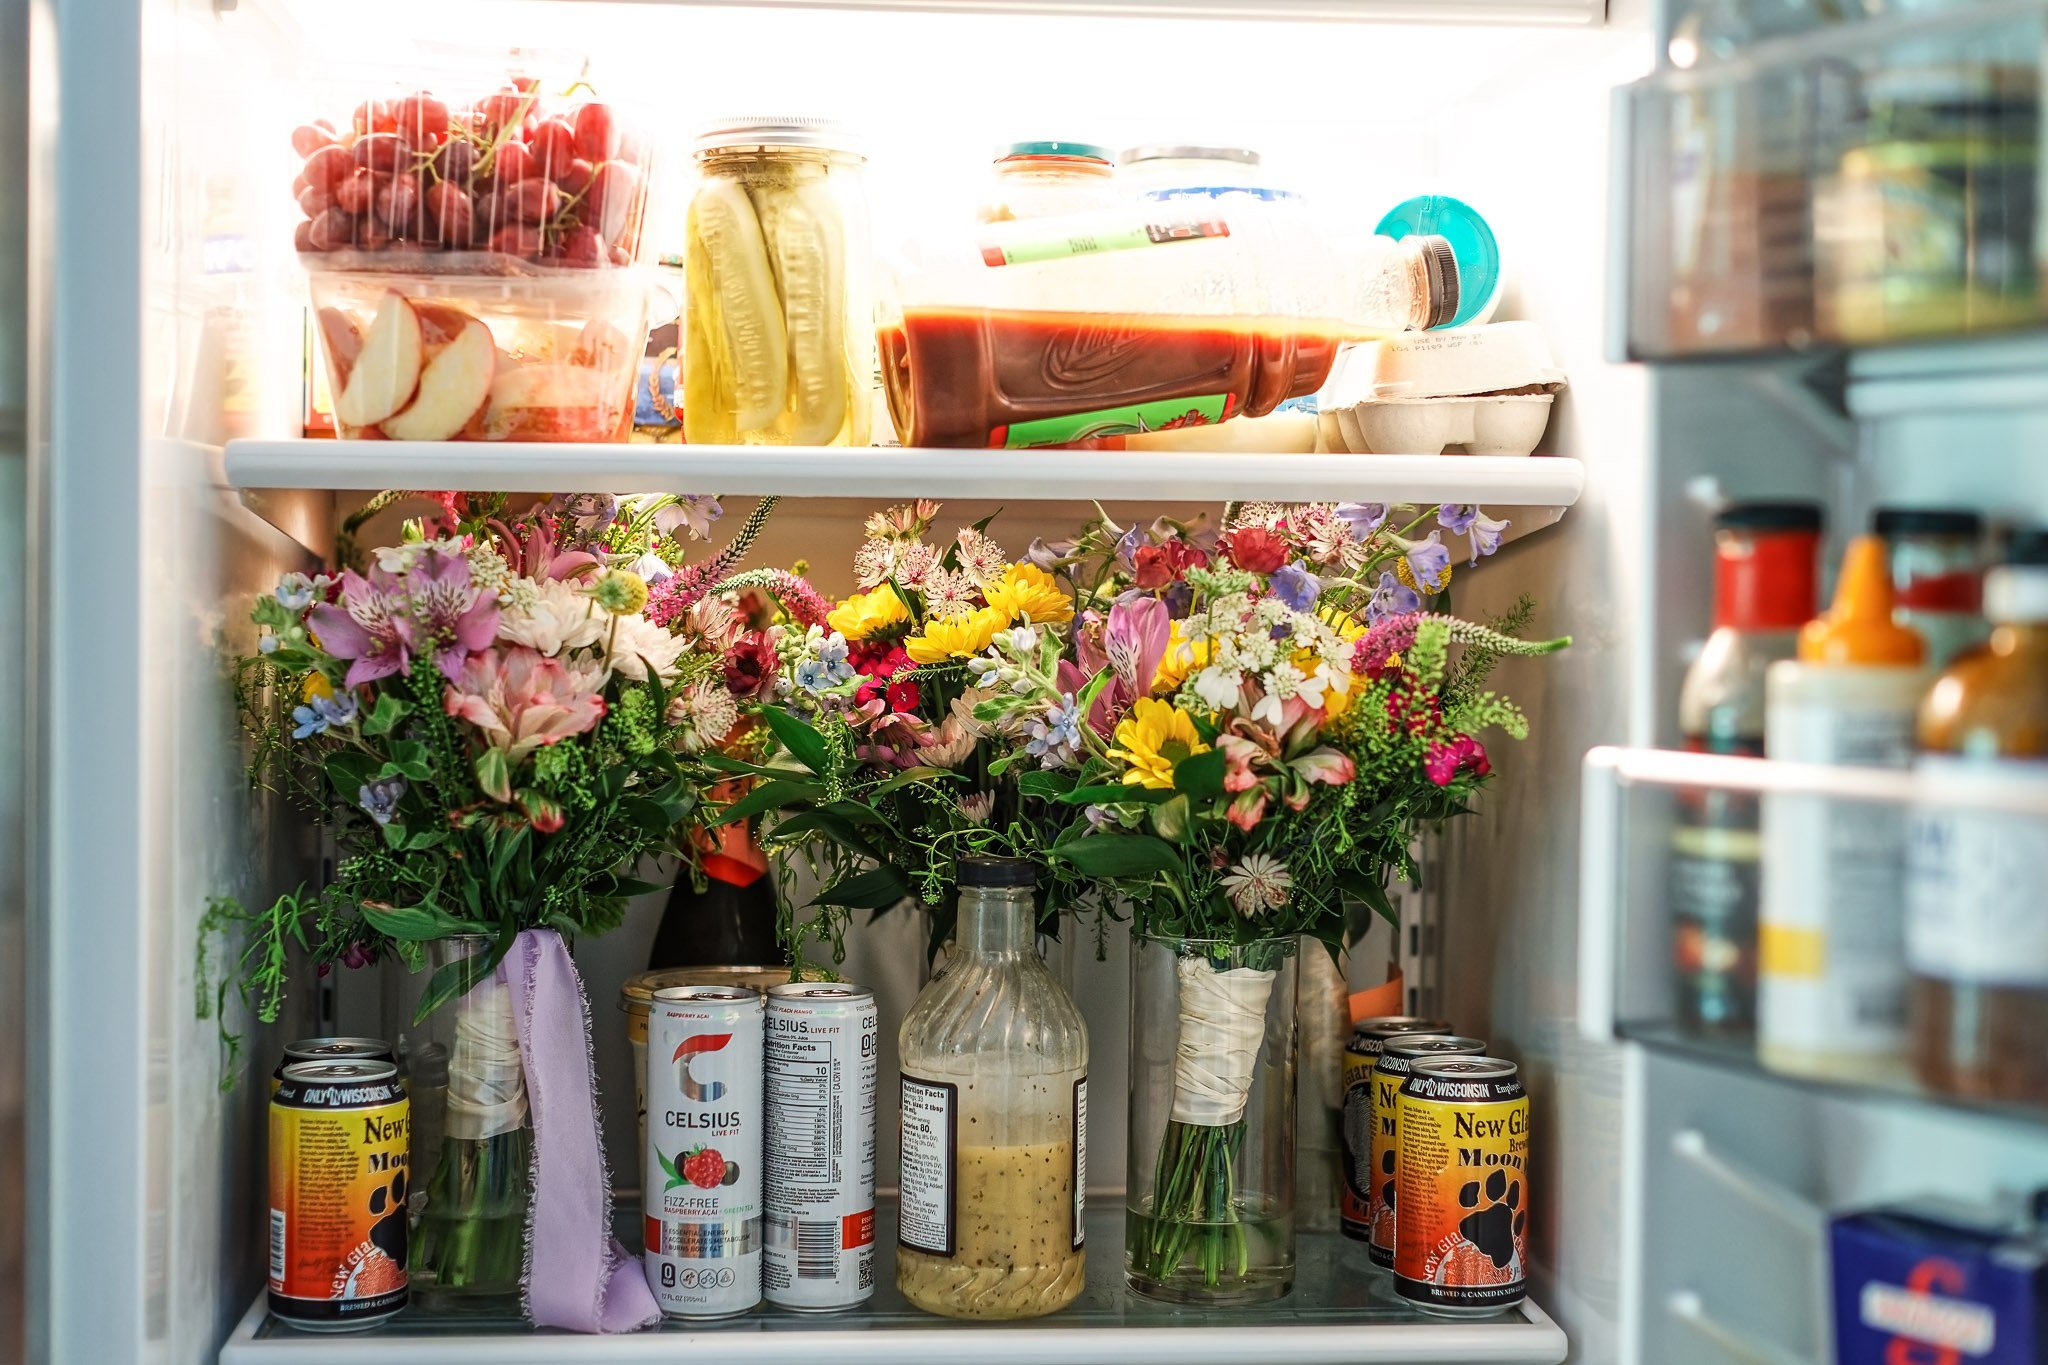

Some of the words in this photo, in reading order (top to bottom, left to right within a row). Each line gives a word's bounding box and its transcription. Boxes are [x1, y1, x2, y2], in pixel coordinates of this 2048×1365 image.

[793, 1043, 817, 1052] Facts
[816, 1066, 828, 1075] 10
[1409, 1077, 1426, 1092] ONLY
[1436, 1081, 1490, 1098] WISCONSIN
[338, 1085, 392, 1104] WISCONSIN
[925, 1089, 945, 1099] Facts
[929, 1104, 944, 1113] tbsp
[362, 1115, 405, 1144] New
[1453, 1111, 1505, 1139] New
[1457, 1147, 1522, 1170] Moon
[664, 1196, 719, 1208] FIZZ-FREE
[664, 1207, 701, 1216] RASPBERRY
[1431, 1288, 1460, 1298] BREWED
[1467, 1289, 1497, 1298] CANNED
